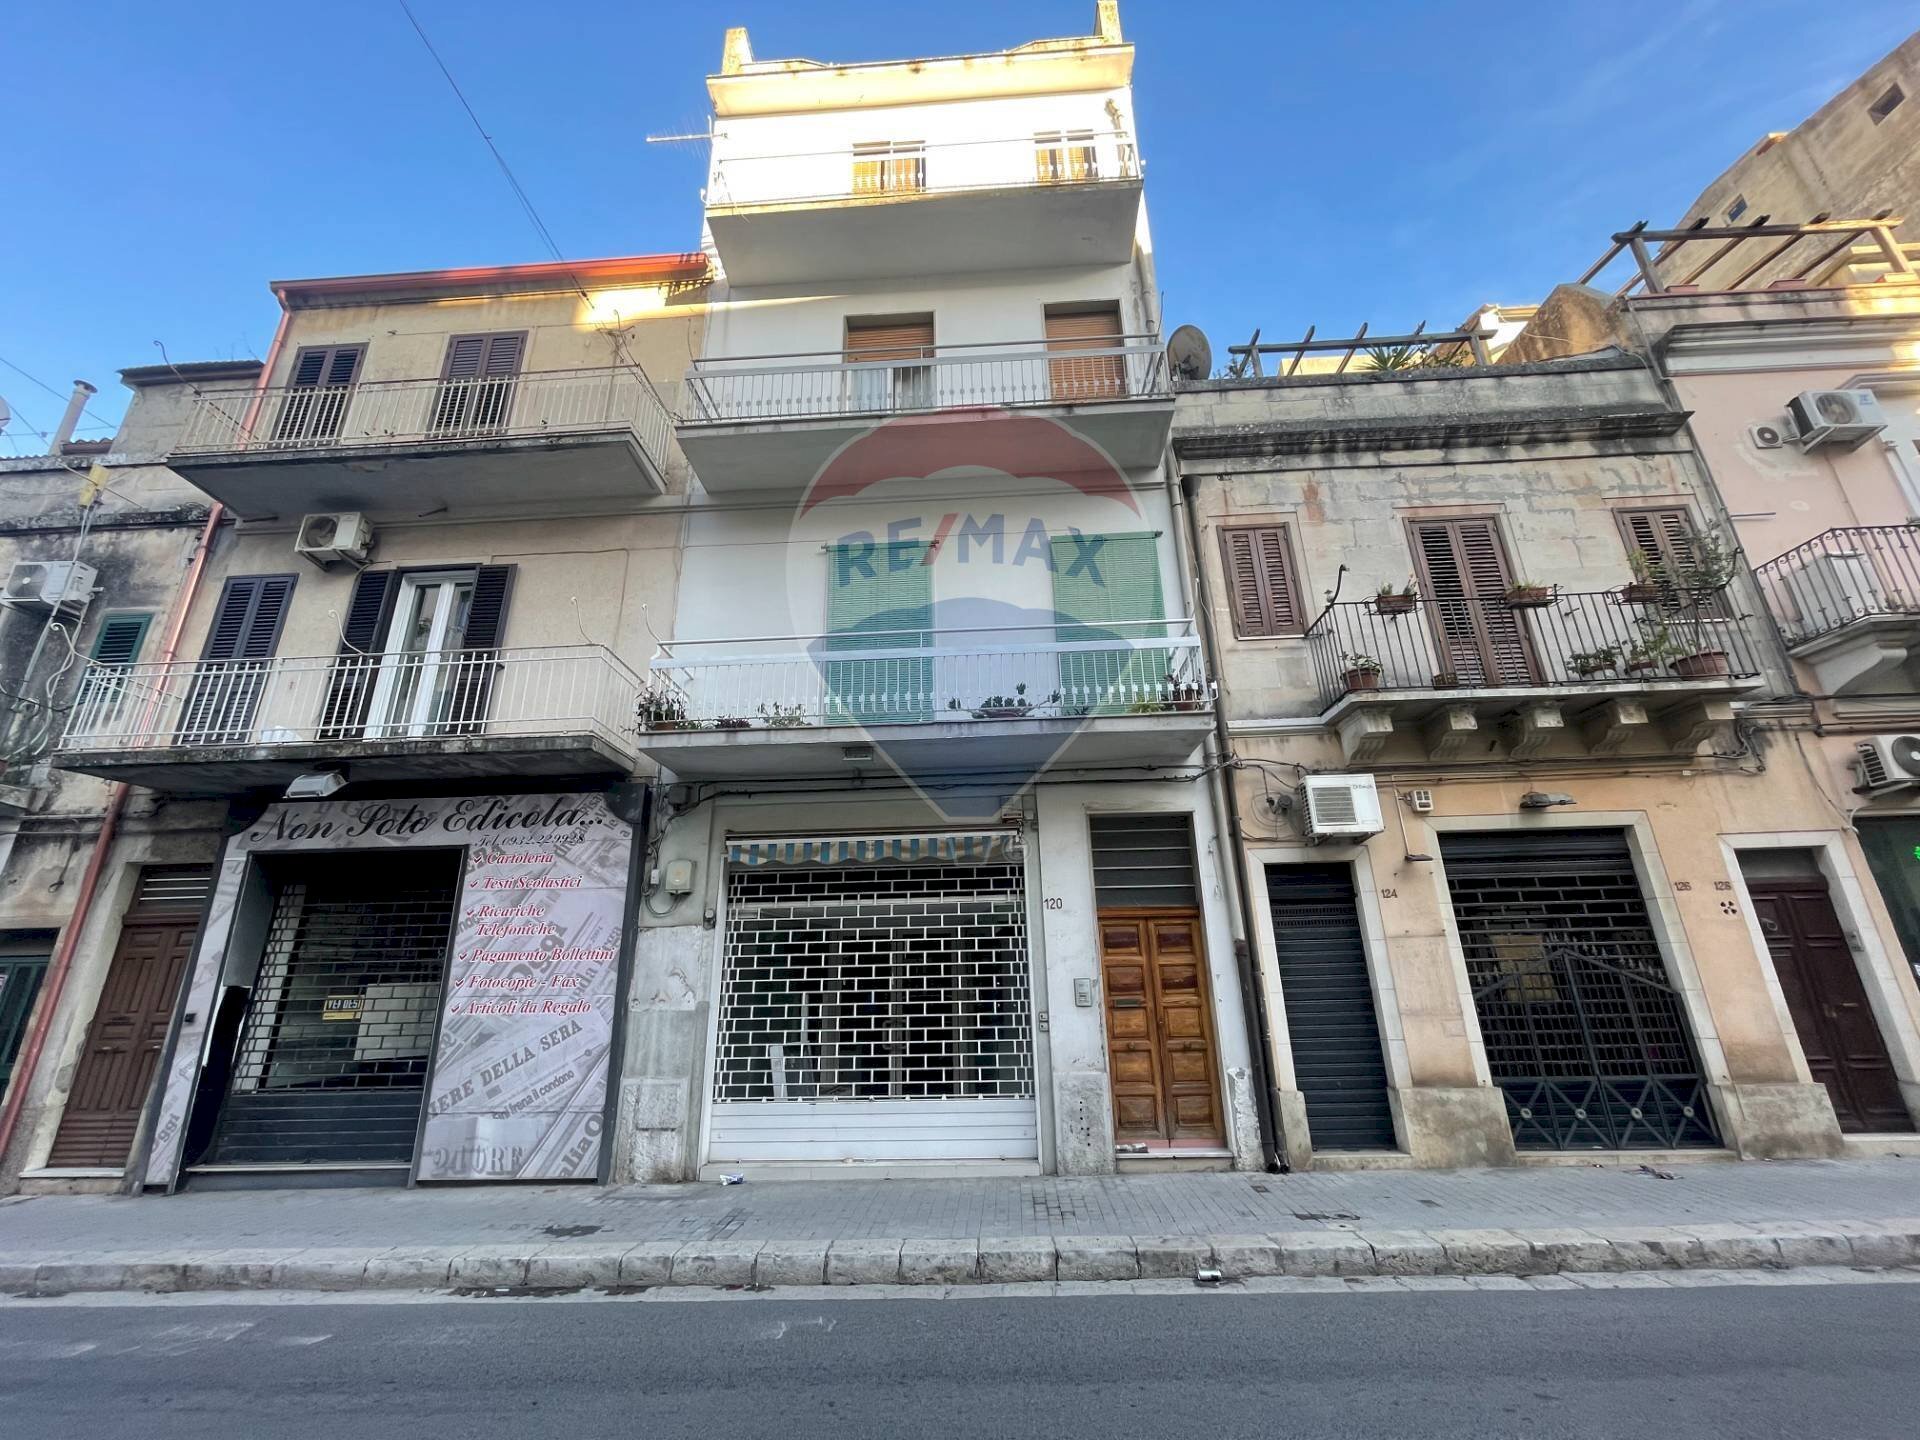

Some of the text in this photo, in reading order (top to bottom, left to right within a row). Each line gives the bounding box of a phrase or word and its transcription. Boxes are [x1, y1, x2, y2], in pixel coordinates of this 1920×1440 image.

[250, 808, 344, 842] Non
[346, 803, 437, 837] Solo
[443, 796, 603, 833] Edicola...
[487, 851, 555, 865] Cartoleria
[483, 875, 583, 889] Testi Scolastici
[1381, 888, 1398, 899] 124
[478, 904, 545, 917] Ricariche
[1043, 898, 1063, 910] 120
[476, 922, 556, 938] Telefoniche
[471, 946, 616, 964] Pagamento Bollettini
[469, 975, 537, 991] Fotocopie
[551, 975, 580, 989] Fax
[467, 999, 592, 1016] Articoli da Regalo
[480, 1046, 537, 1088] DELLA
[540, 1019, 584, 1052] SERA
[539, 1068, 576, 1097] condono
